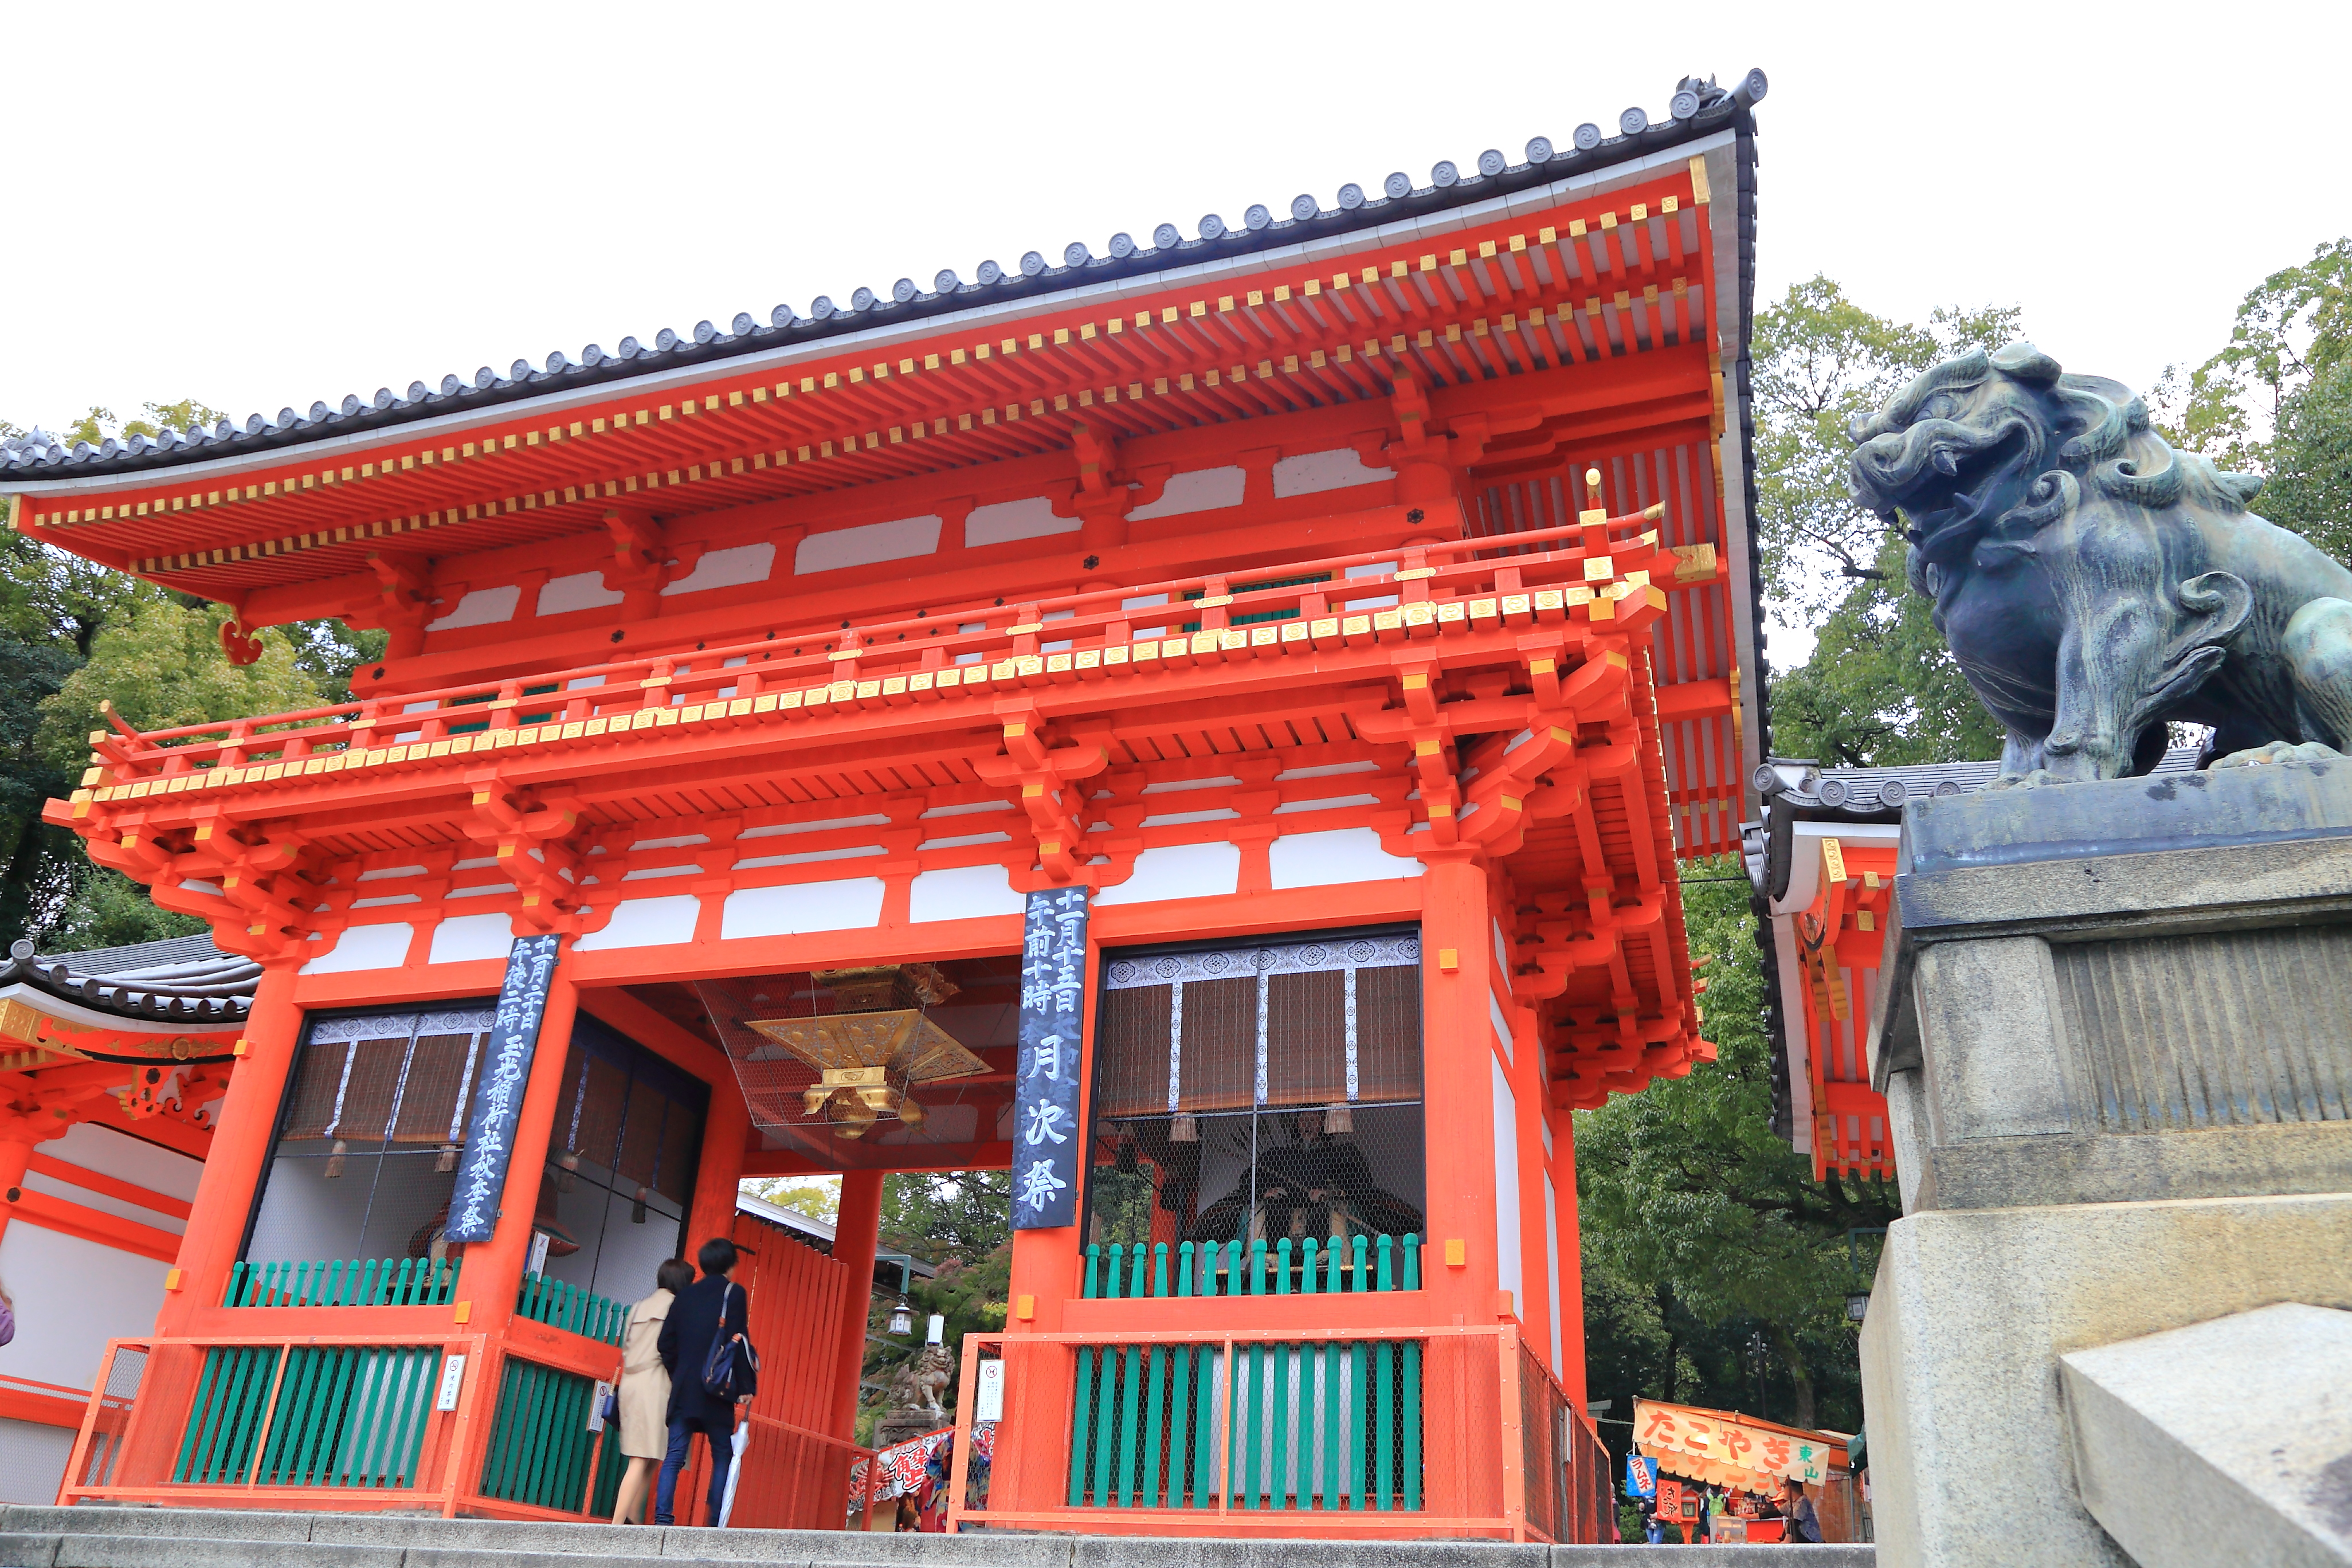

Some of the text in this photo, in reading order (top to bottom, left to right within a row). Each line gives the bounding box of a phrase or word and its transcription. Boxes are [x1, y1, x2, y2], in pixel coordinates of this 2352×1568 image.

[495, 938, 532, 1033] 午後二時
[521, 935, 556, 1030] 十一月二十日
[1022, 895, 1056, 1016] 午前十時
[1050, 890, 1085, 1013] 十一月十五日
[1017, 1034, 1067, 1213] 月次祭
[1632, 1459, 1651, 1489] ラムネ
[1644, 1410, 1790, 1470] たこやき
[1798, 1444, 1820, 1480] 東山
